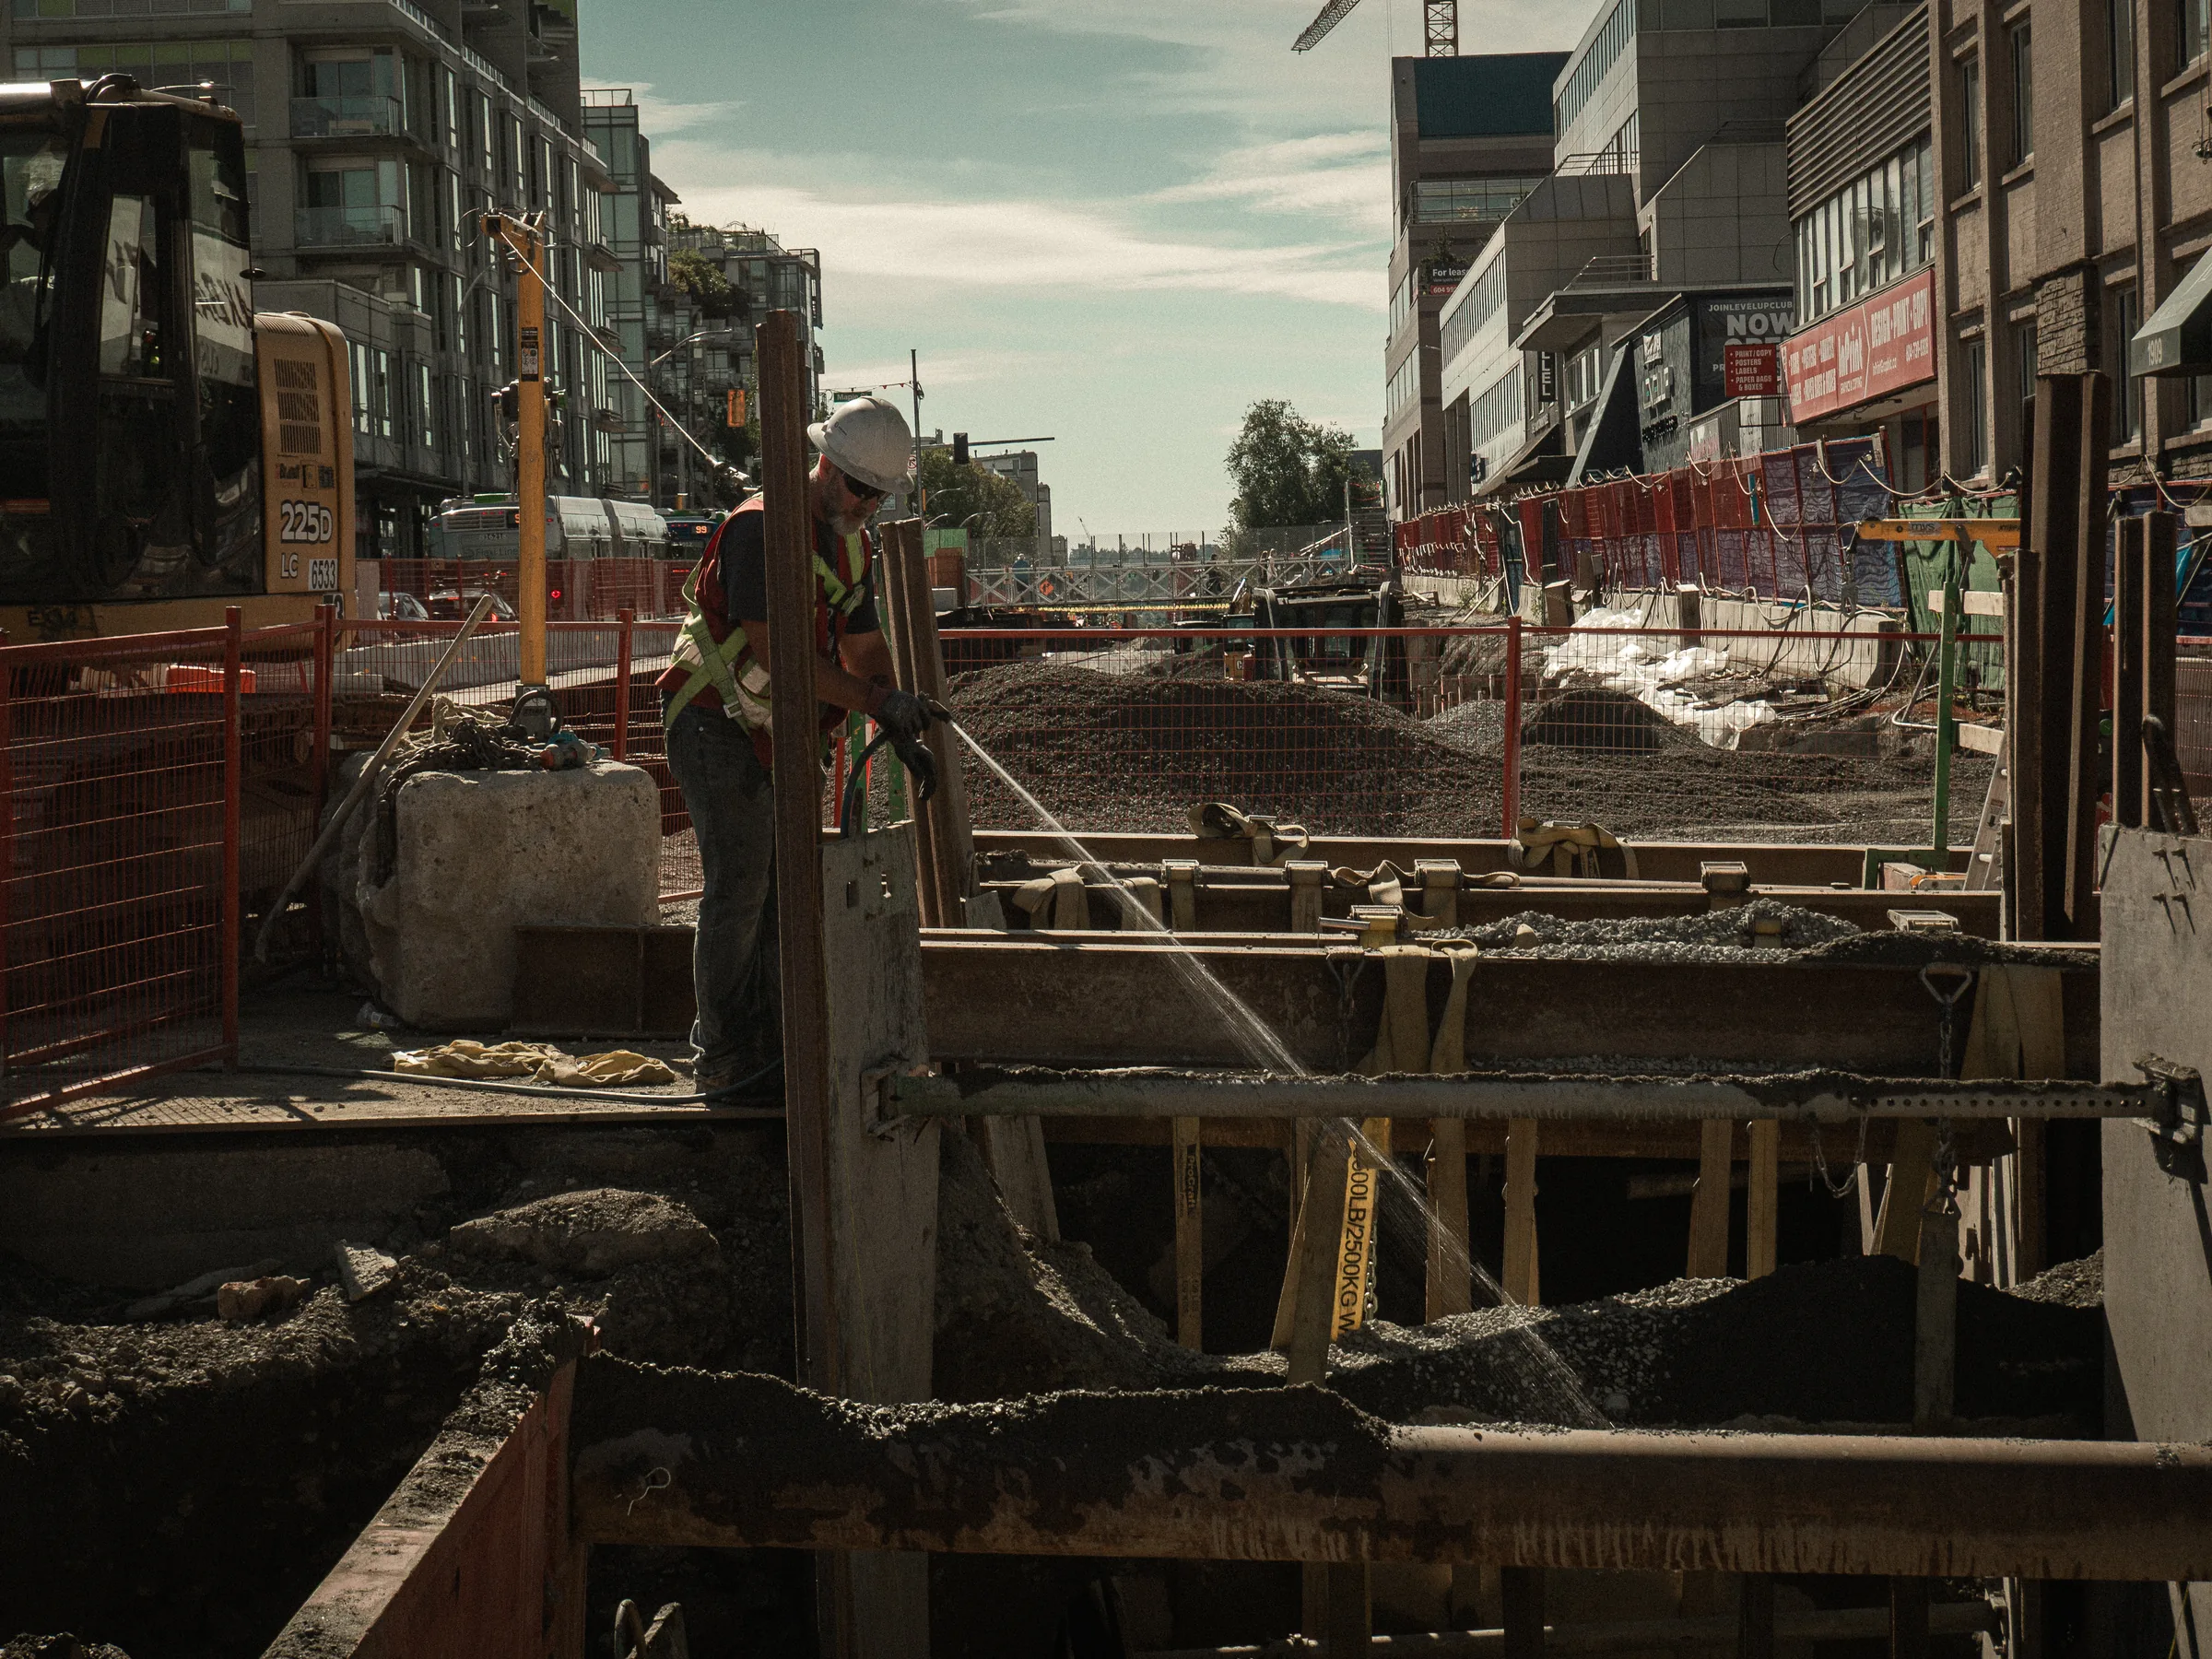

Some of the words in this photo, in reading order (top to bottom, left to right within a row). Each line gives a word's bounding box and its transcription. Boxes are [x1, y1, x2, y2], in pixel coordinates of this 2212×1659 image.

[1432, 268, 1447, 276] For
[1726, 312, 1794, 336] NOW
[1735, 359, 1762, 367] POSTERS
[2147, 337, 2163, 366] 1909
[1735, 367, 1758, 375] LABELS
[1744, 382, 1763, 391] BOXES
[281, 500, 333, 544] 225D
[695, 525, 708, 535] 99
[281, 552, 299, 579] LC
[312, 559, 335, 590] 6533
[1186, 1155, 1195, 1208] ProCraft
[1340, 1149, 1370, 1307] 00LB/2500KG
